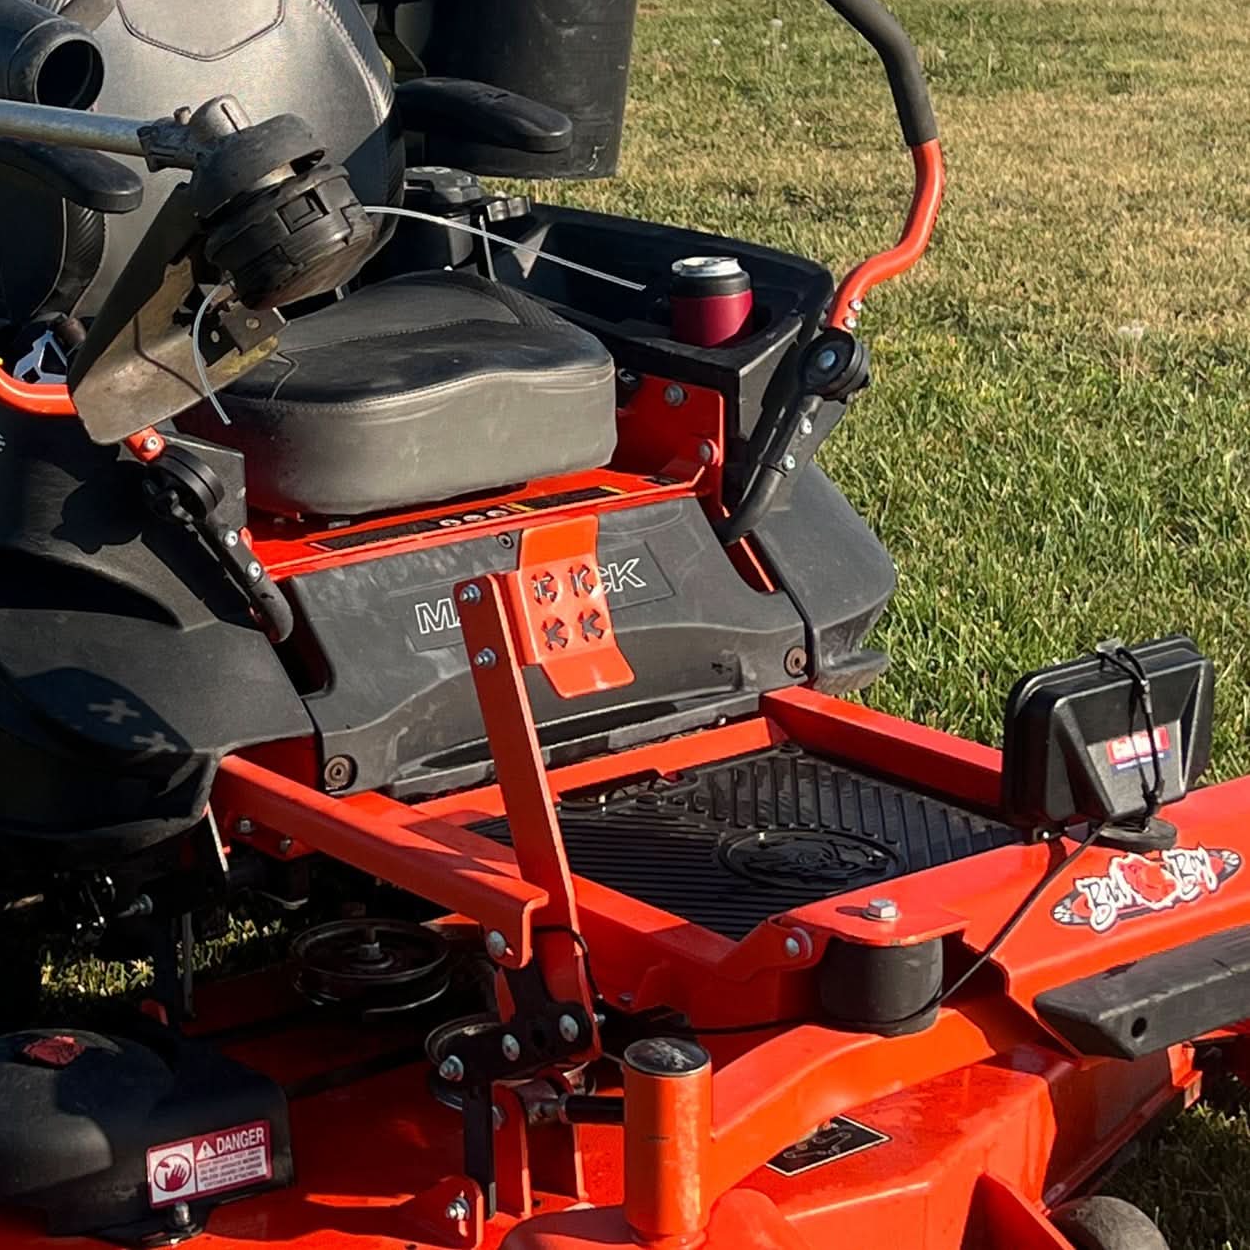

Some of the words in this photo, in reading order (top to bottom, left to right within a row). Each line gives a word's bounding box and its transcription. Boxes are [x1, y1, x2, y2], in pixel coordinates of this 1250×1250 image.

[1074, 856, 1140, 932] Bad
[1162, 845, 1218, 900] Boy
[216, 1127, 265, 1154] DANGER
